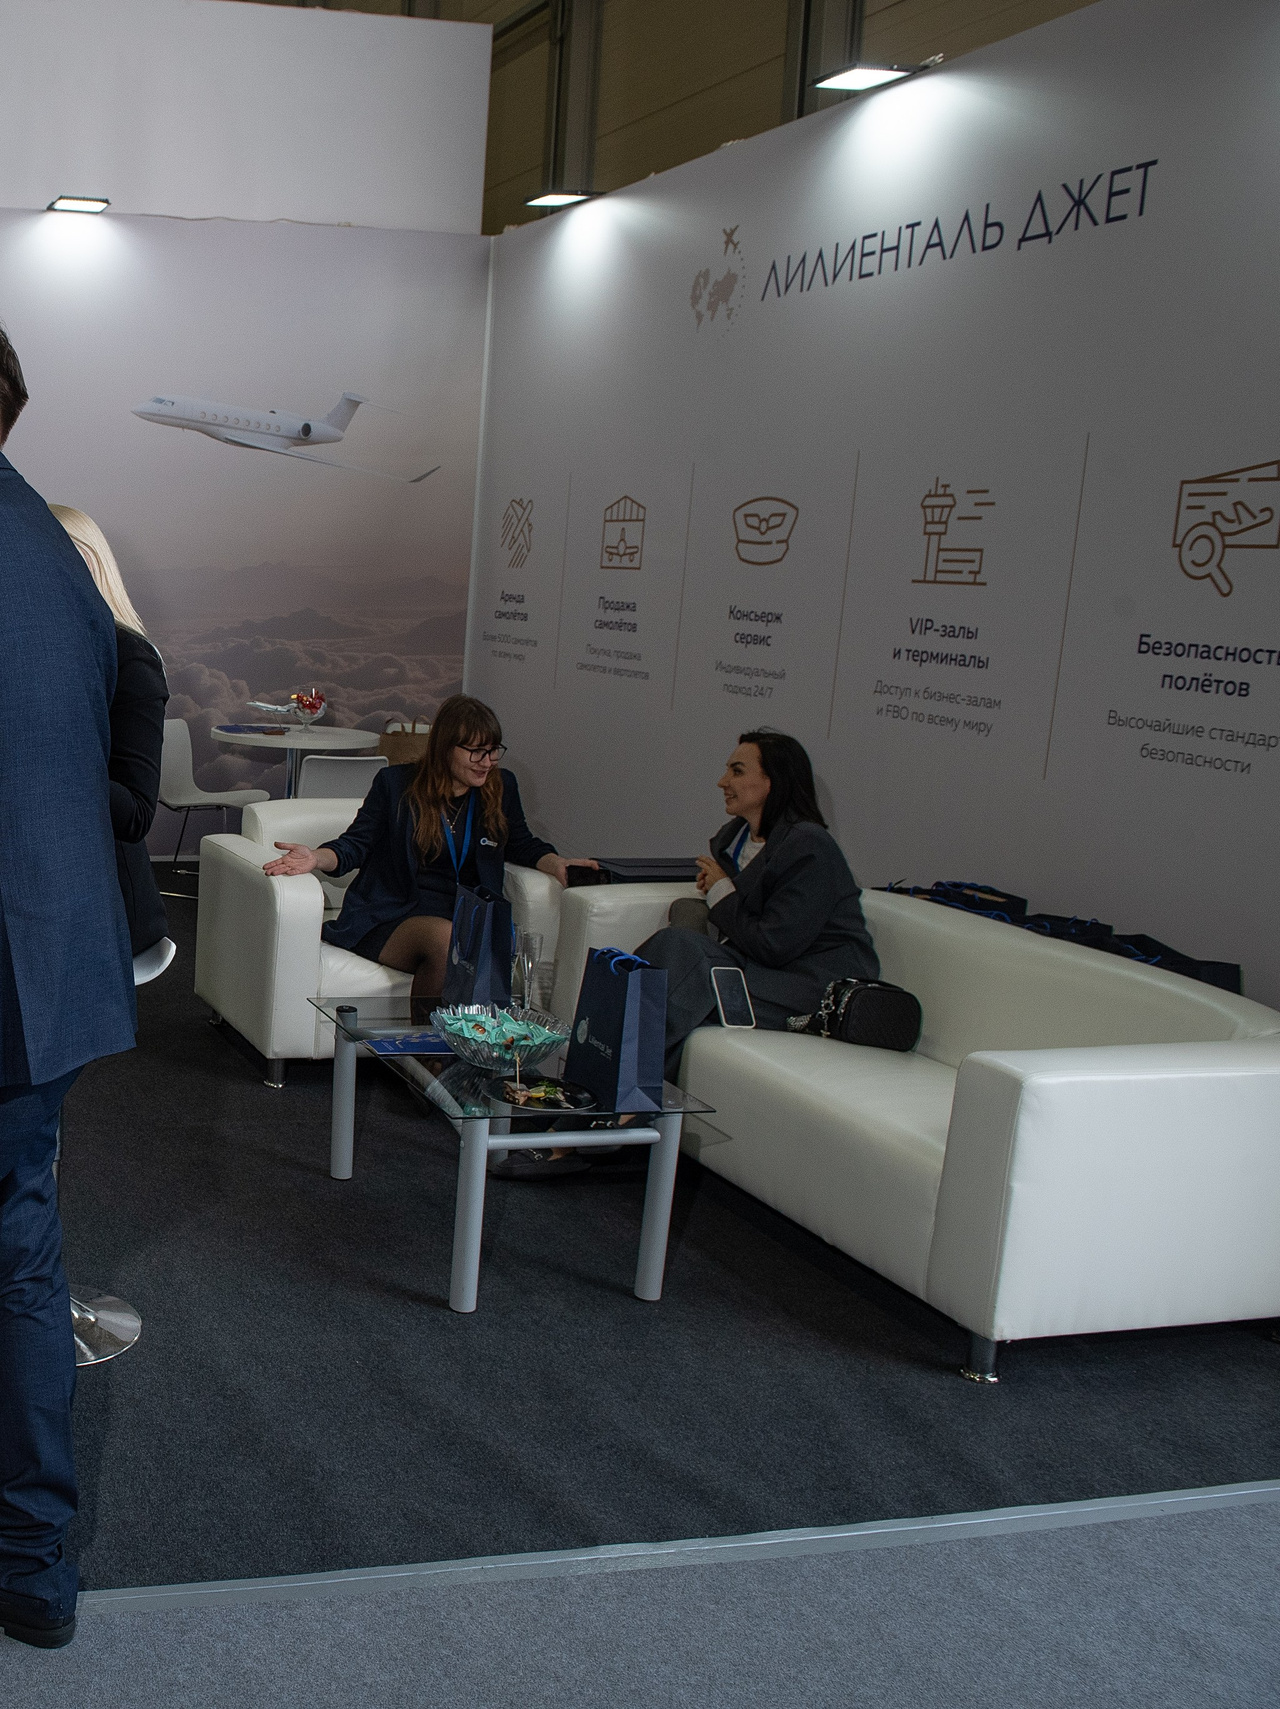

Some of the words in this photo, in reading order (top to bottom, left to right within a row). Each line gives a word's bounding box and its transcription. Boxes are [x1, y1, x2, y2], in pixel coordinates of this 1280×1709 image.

[760, 202, 1005, 302] ЛИЛИЕНТАЛЬ
[1017, 158, 1159, 251] ДЖЕТ
[499, 590, 525, 604] Аренда
[598, 596, 637, 613] Продажа
[494, 608, 528, 622] самолётов
[594, 618, 637, 633] самолётов
[728, 605, 783, 626] Консьерж
[909, 617, 978, 640] VIP-залы
[733, 631, 772, 648] сервис
[893, 648, 902, 660] и
[905, 648, 989, 670] терминалы
[715, 660, 786, 681] Индивидуальный
[722, 681, 752, 699] подход
[752, 684, 774, 699] 24/7
[873, 679, 912, 700] Доступ
[914, 686, 921, 699] к
[922, 687, 1002, 710] бизнес-залам
[1161, 673, 1251, 698] полётов
[876, 705, 884, 717] и
[885, 703, 909, 720] FBO
[911, 710, 925, 724] по
[926, 713, 961, 733] всему
[962, 719, 994, 737] миру
[1107, 708, 1205, 738] Высочайшие
[1209, 727, 1280, 752] стандар
[1140, 743, 1252, 775] безопасности
